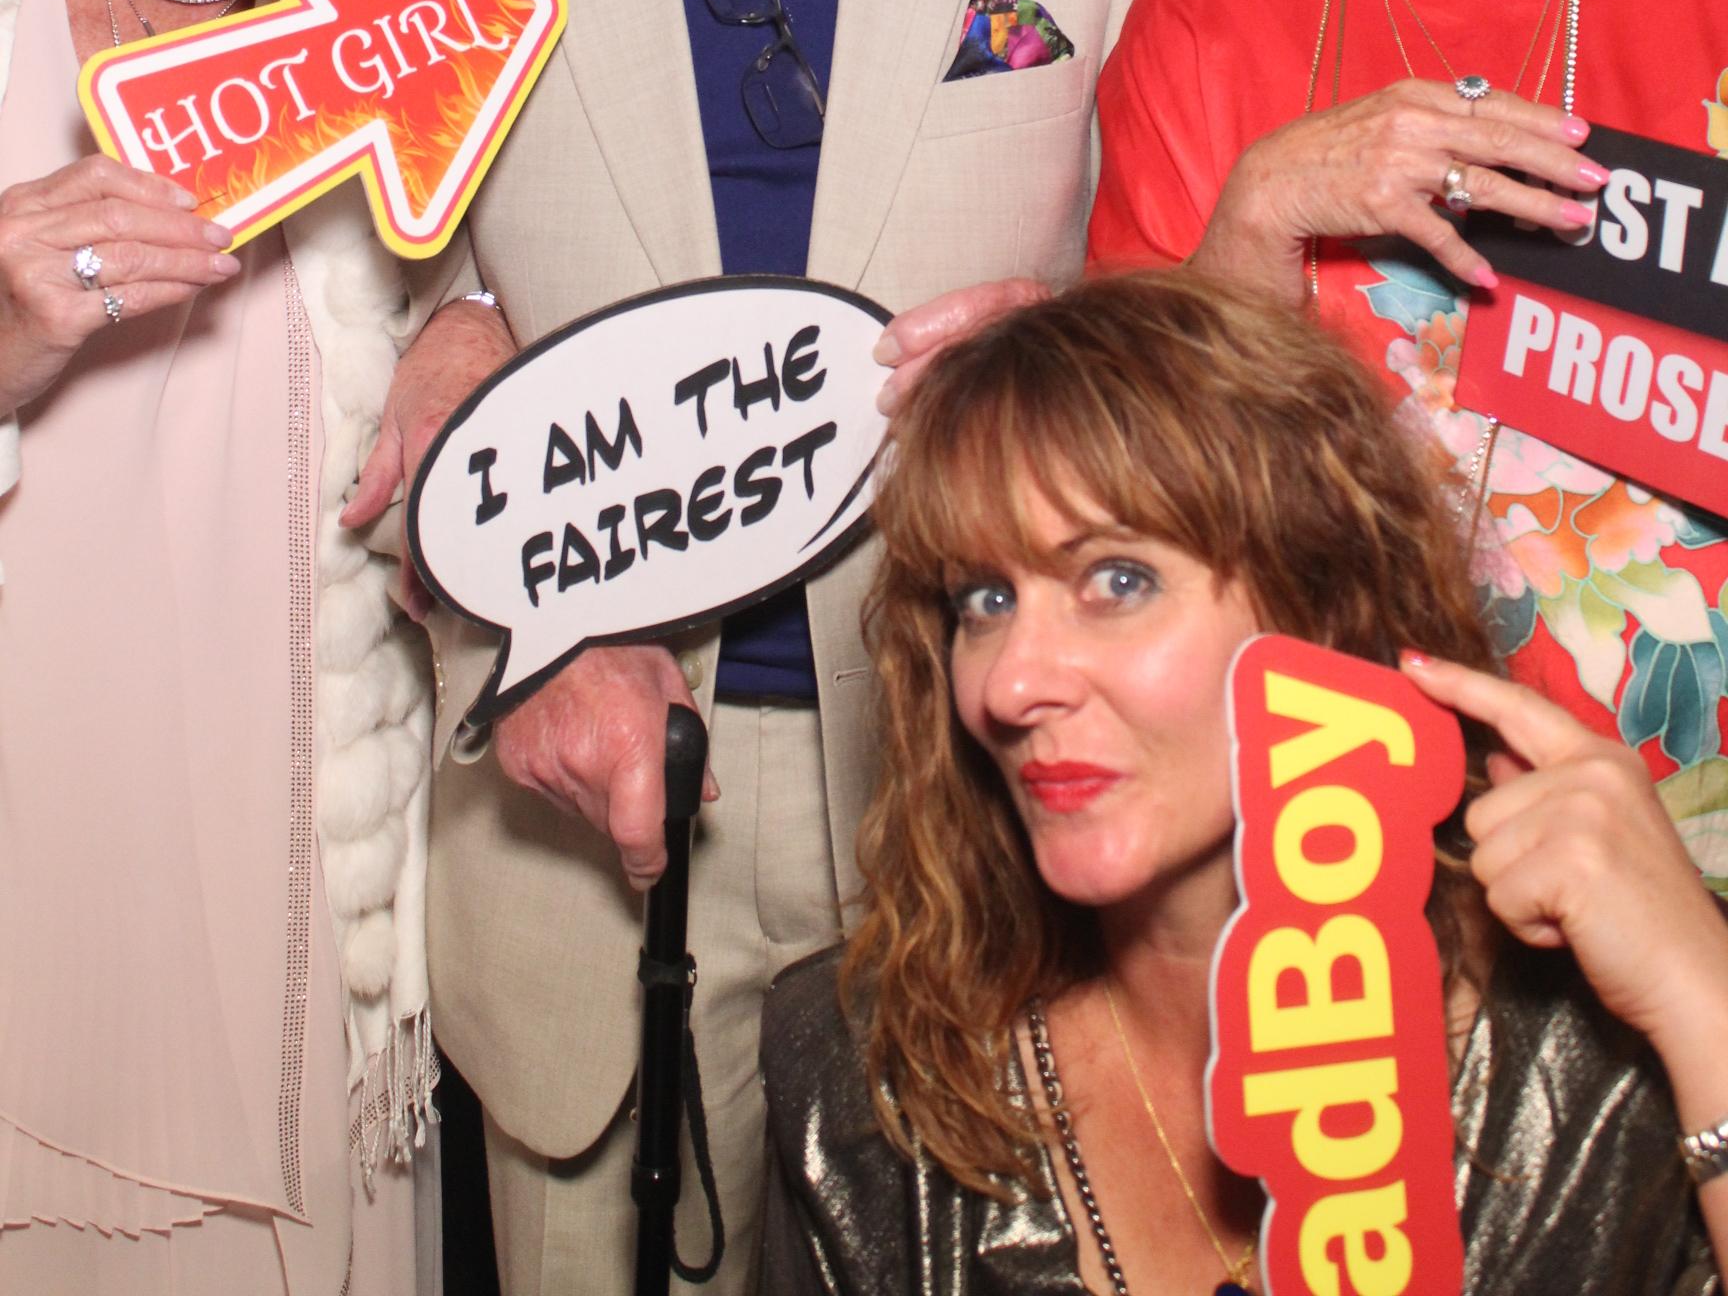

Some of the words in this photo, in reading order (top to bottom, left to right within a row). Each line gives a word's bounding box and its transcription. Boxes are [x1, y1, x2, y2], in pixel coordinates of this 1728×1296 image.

[142, 48, 315, 174] HOT
[468, 447, 507, 525] I
[543, 397, 642, 493] AM
[674, 325, 827, 438] THE
[521, 421, 837, 608] FAIREST
